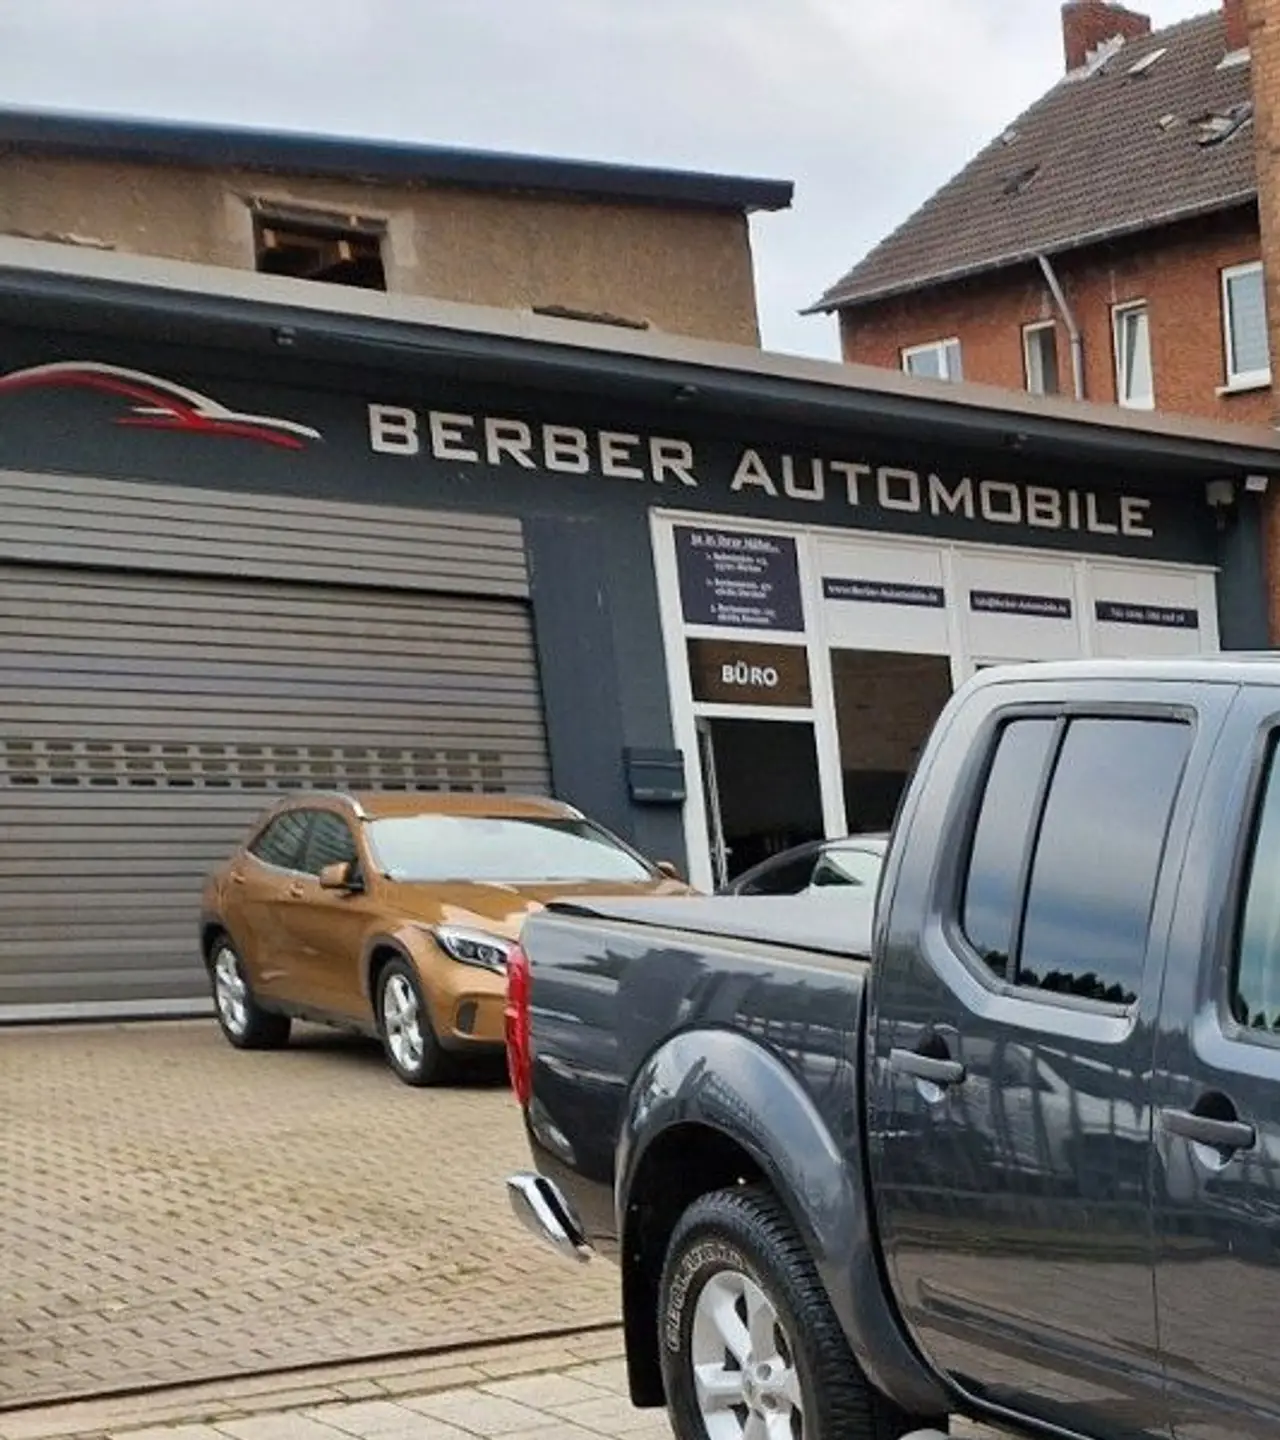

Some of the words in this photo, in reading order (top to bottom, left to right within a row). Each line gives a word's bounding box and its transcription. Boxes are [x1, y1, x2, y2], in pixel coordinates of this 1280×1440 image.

[368, 403, 698, 487] BERBER
[729, 448, 1154, 538] AUTOMOBILE
[721, 659, 779, 687] BÜRO
